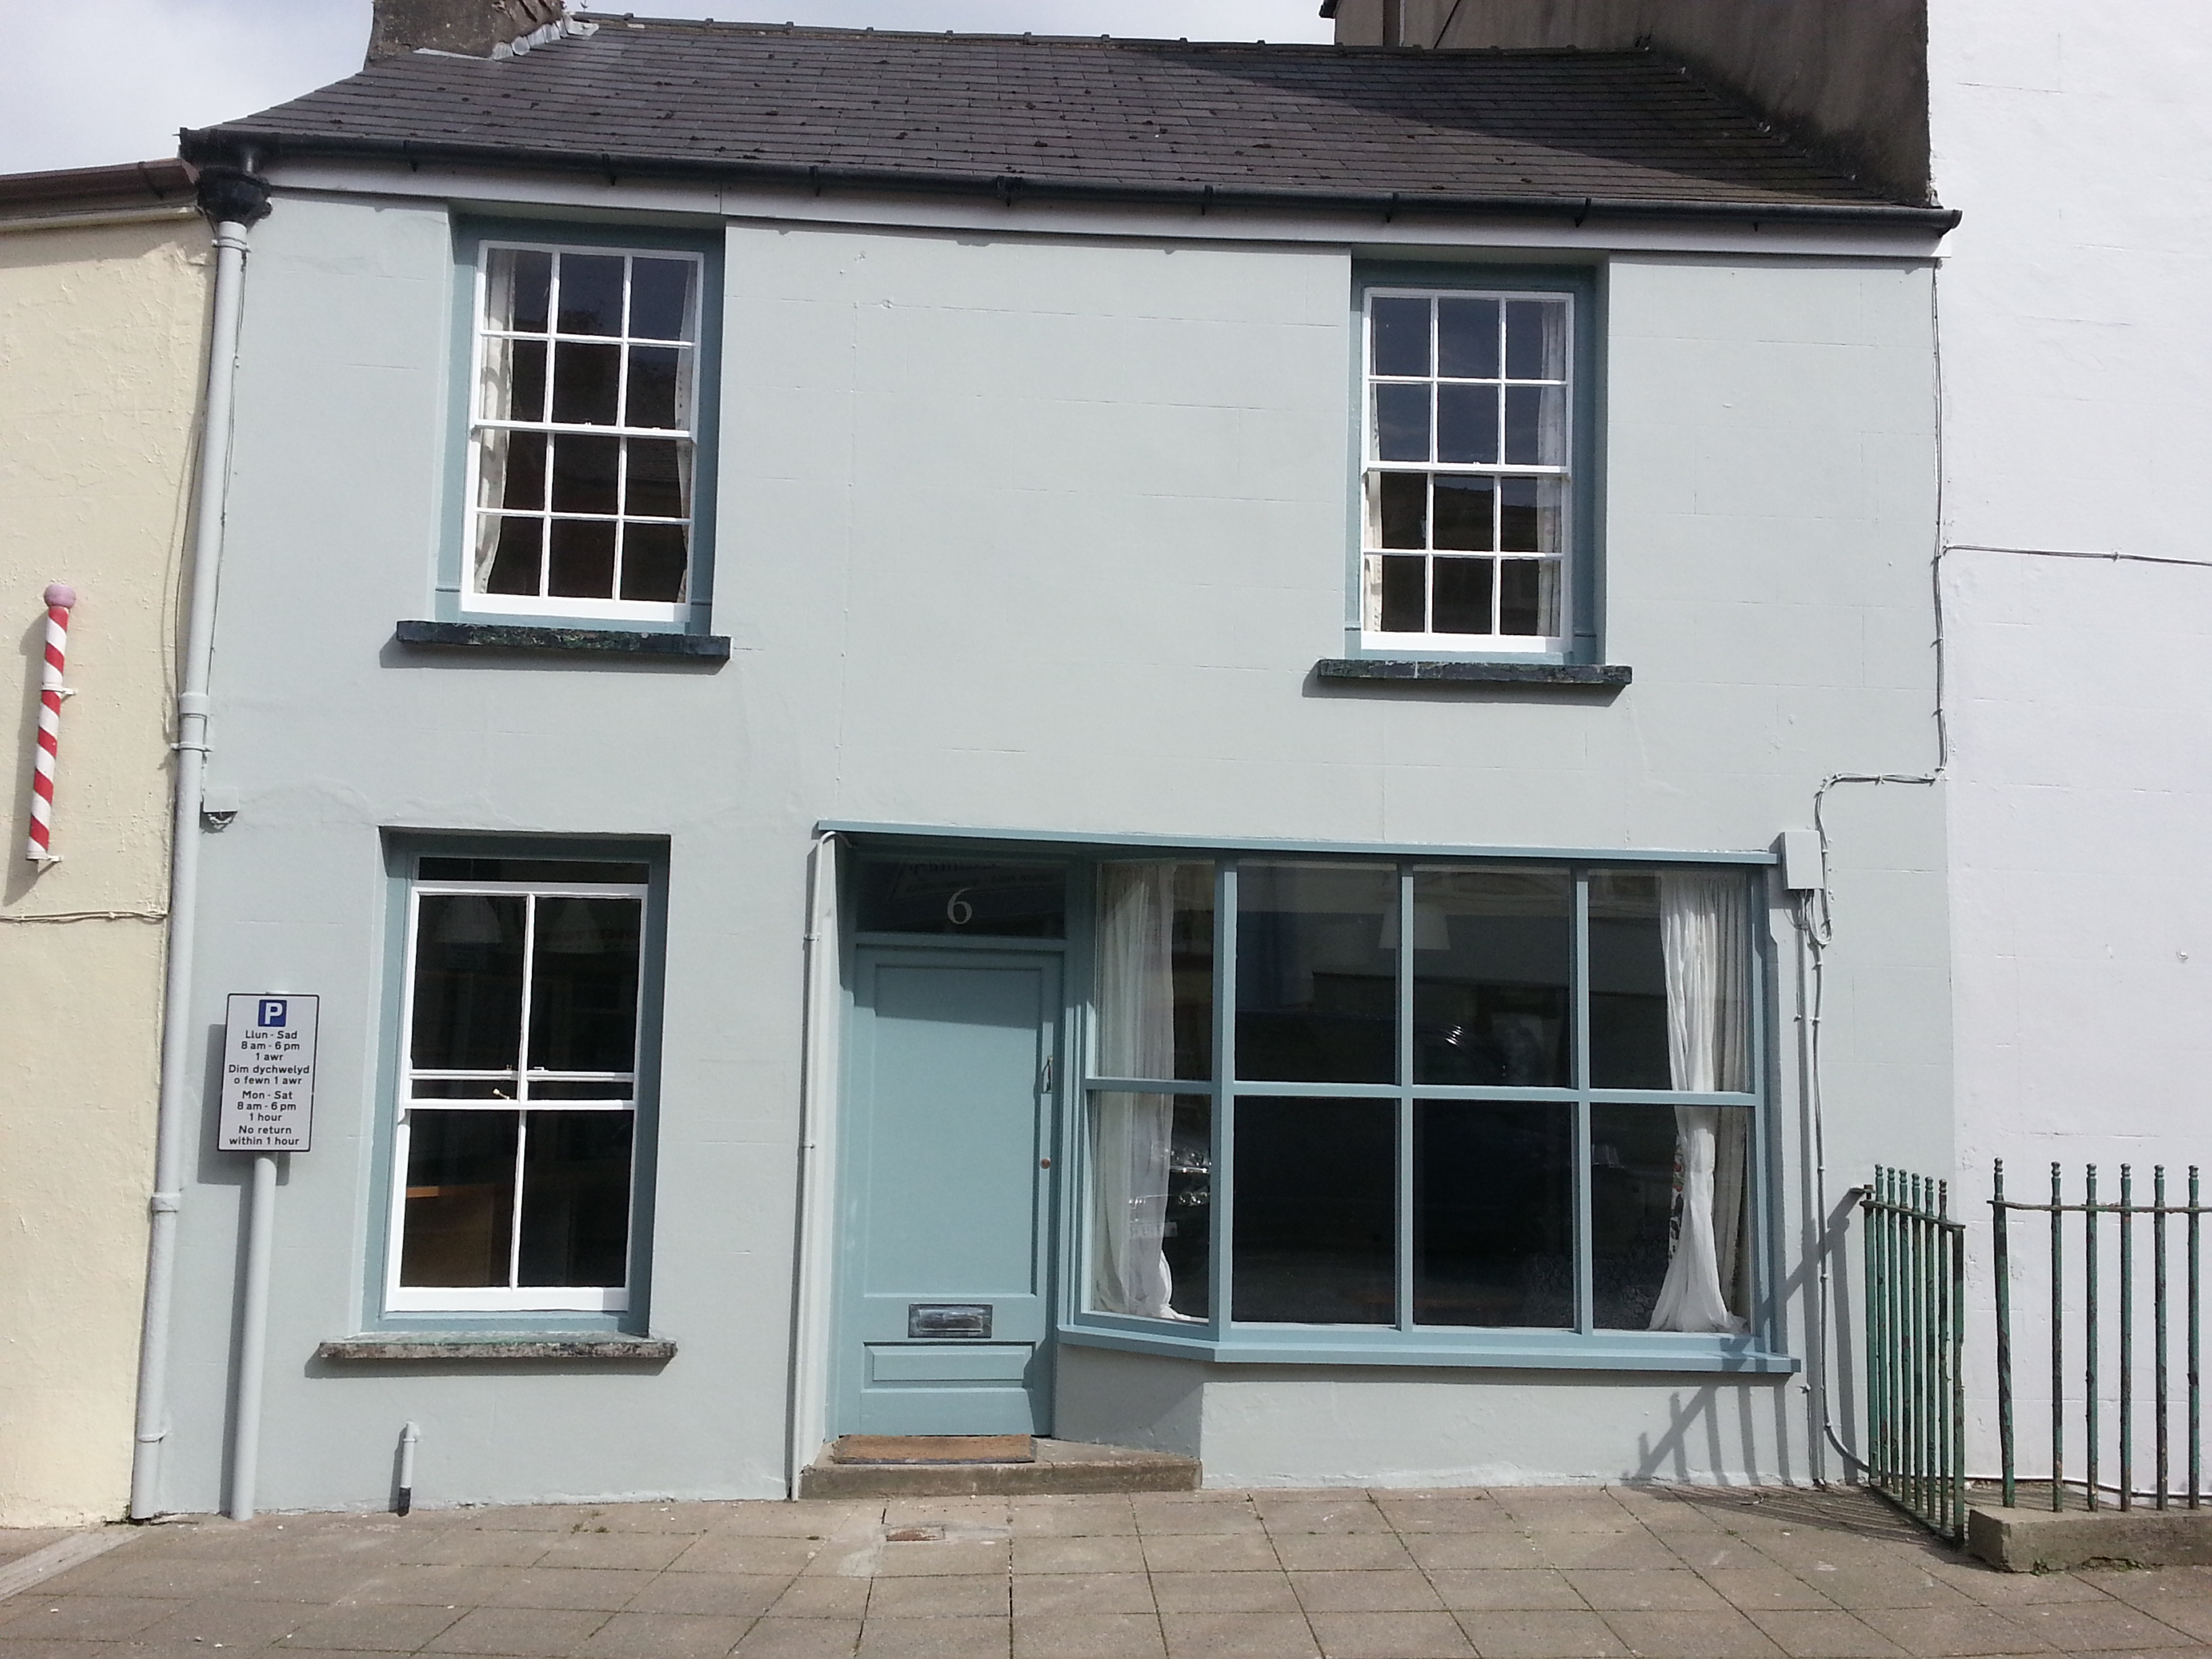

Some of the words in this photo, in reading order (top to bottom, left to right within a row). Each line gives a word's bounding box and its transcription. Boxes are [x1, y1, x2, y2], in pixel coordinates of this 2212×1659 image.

[947, 887, 972, 924] 6
[264, 1002, 283, 1025] P
[245, 1030, 268, 1039] Llun
[277, 1031, 298, 1039] Sad
[241, 1041, 247, 1049] 8
[275, 1042, 281, 1050] 6
[284, 1044, 300, 1052] pm
[256, 1052, 260, 1061] 1
[229, 1065, 249, 1073] Dim
[253, 1065, 309, 1076] dychwelyd
[244, 1076, 270, 1084] fewn
[274, 1076, 278, 1084] 1
[242, 1091, 265, 1099] Mon
[274, 1091, 293, 1099] Sat
[237, 1102, 243, 1110] 8
[271, 1102, 277, 1110] 6
[258, 1113, 282, 1121] hour
[239, 1126, 253, 1134] No
[229, 1136, 262, 1145] within
[275, 1137, 300, 1145] hour
